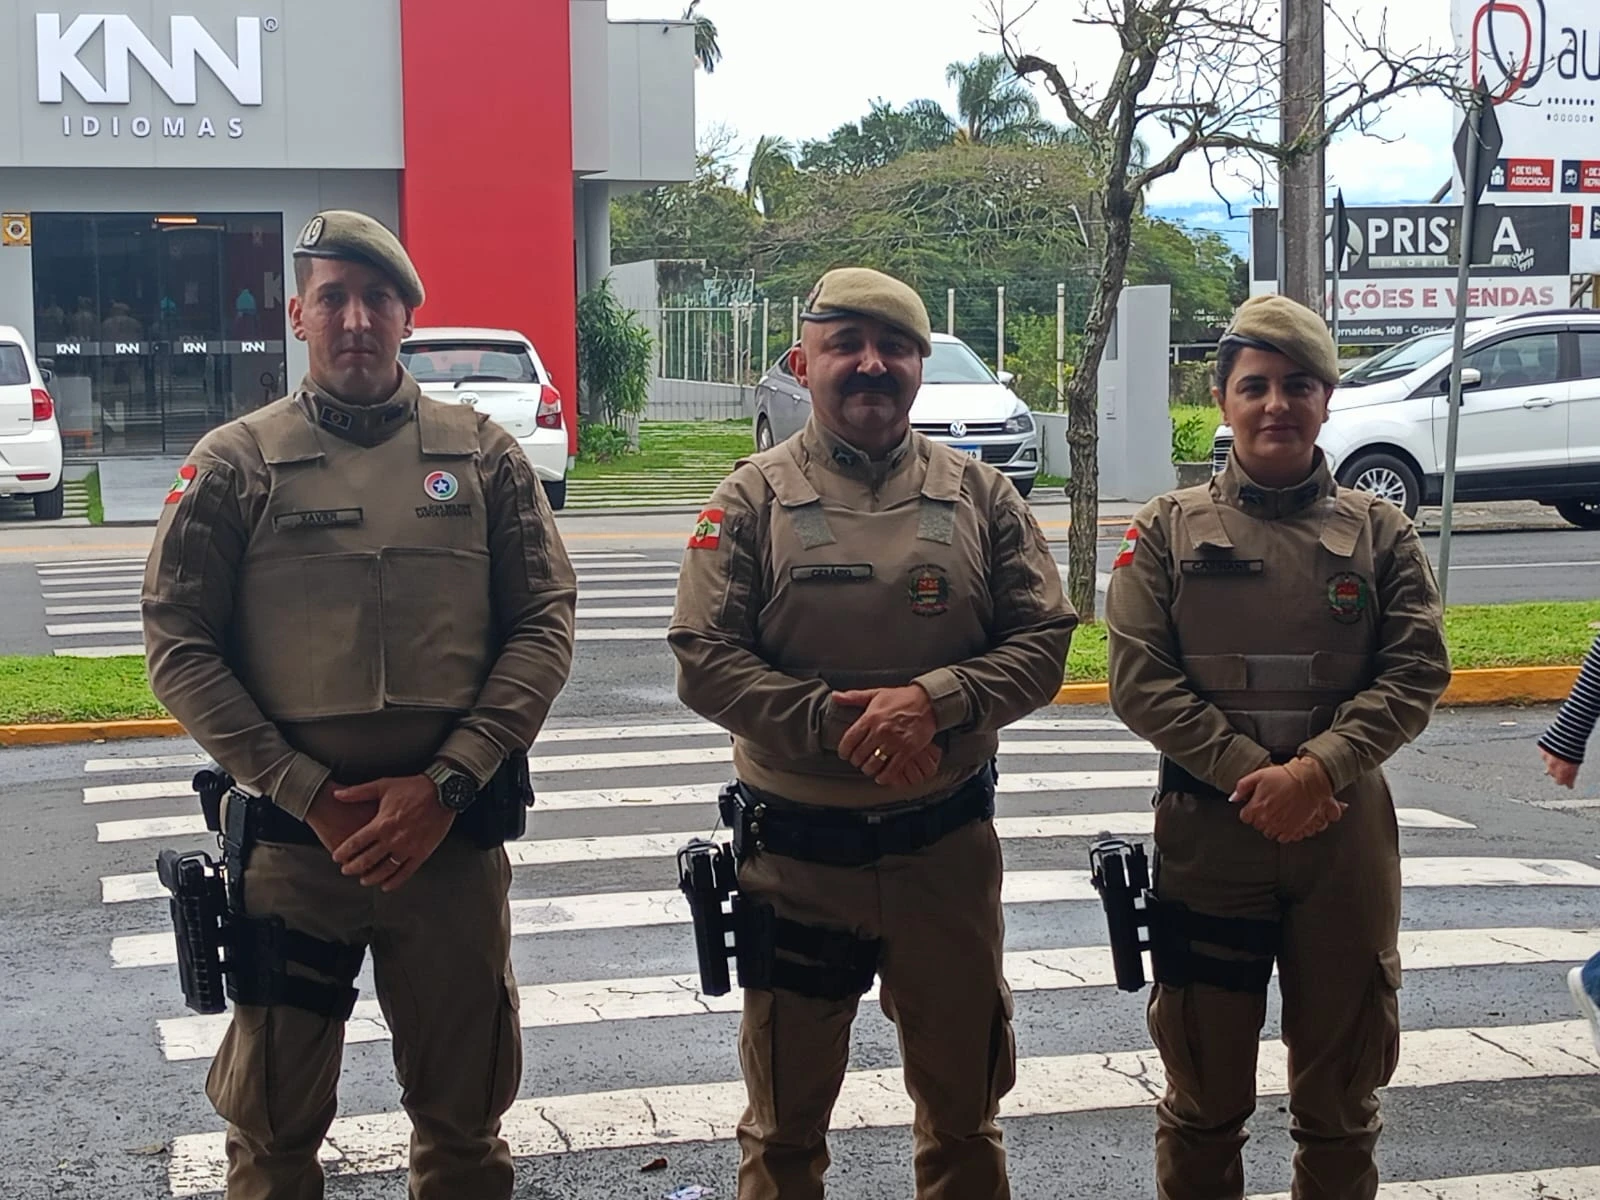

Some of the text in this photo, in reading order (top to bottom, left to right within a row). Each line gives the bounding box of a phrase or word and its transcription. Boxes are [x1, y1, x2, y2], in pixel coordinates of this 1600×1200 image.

[36, 12, 263, 106] KNN
[63, 115, 244, 138] IDIOMAS
[1368, 216, 1523, 255] PRISA
[1423, 288, 1437, 307] E
[1445, 286, 1554, 308] VENDAS
